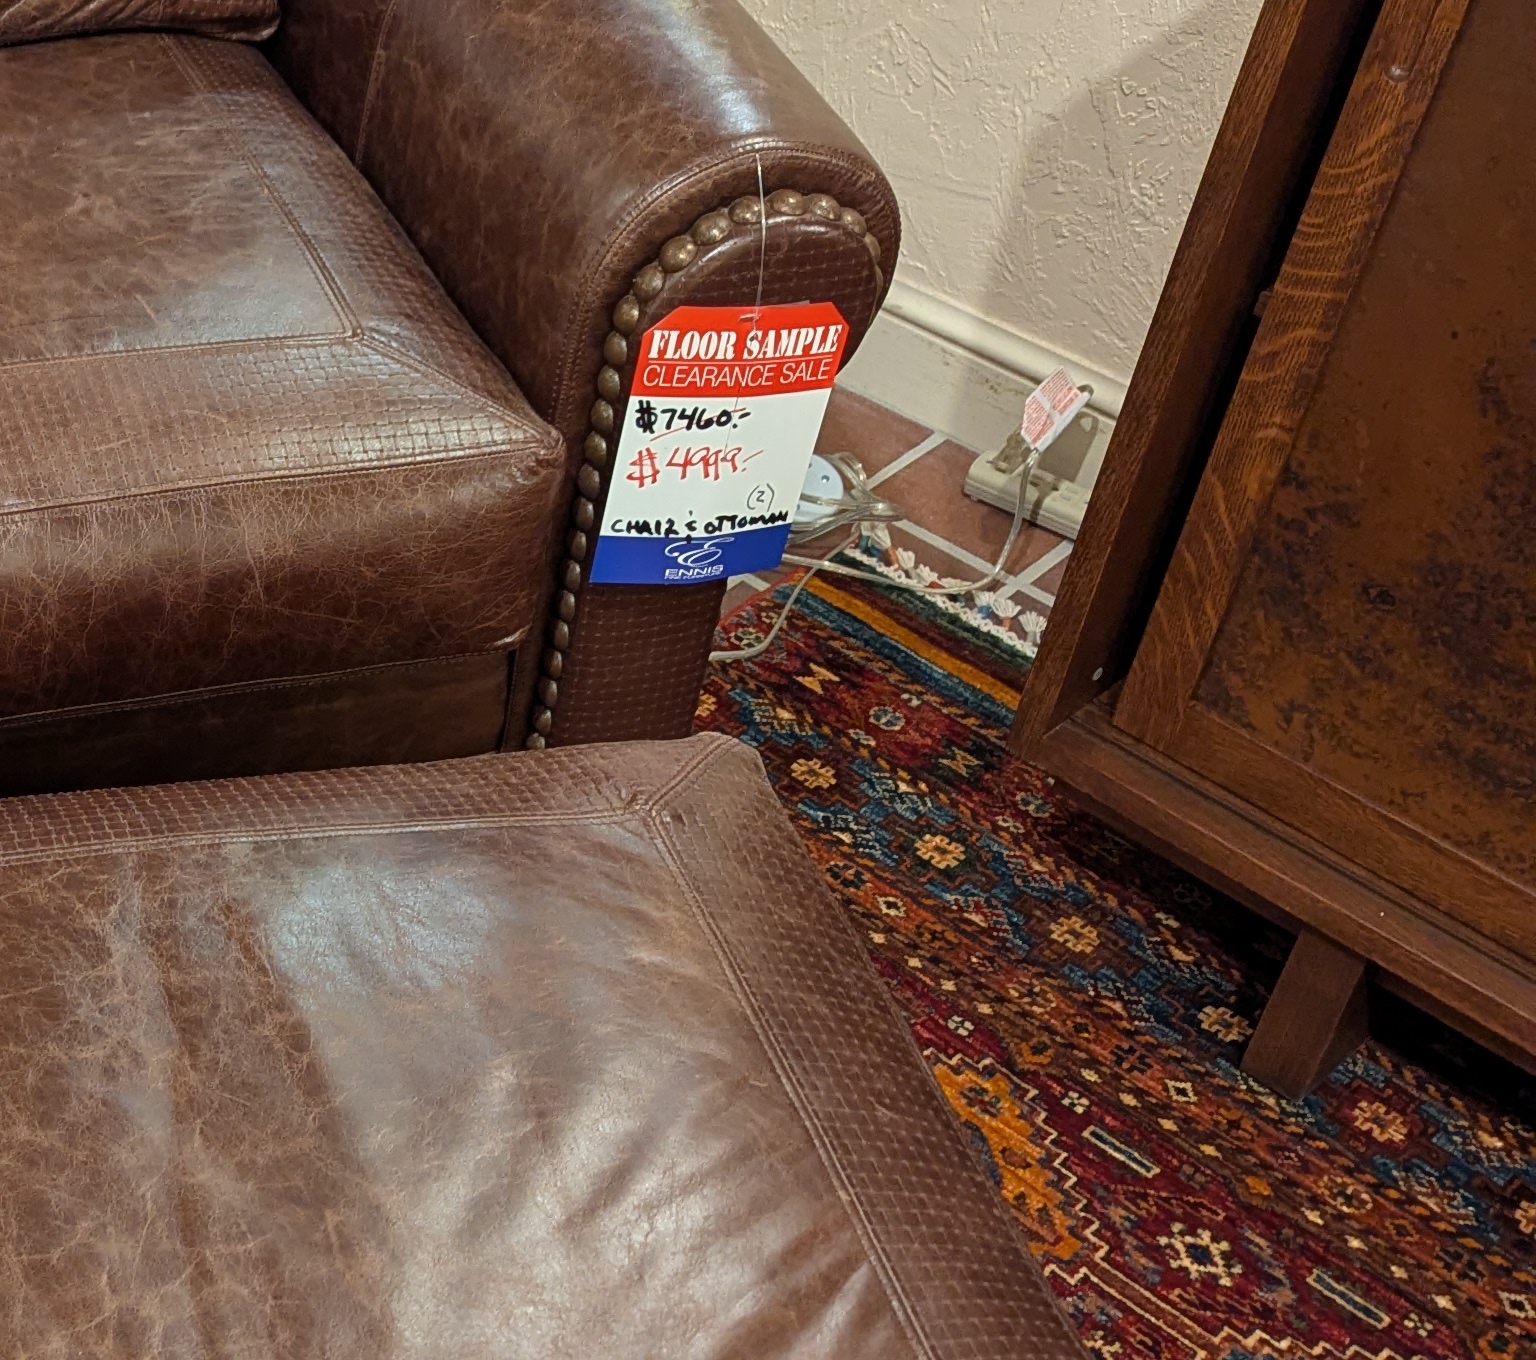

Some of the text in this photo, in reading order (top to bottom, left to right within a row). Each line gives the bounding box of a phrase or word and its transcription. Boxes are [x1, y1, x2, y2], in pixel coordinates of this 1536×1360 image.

[648, 324, 843, 360] FLOOR SAMPLE
[643, 358, 833, 387] CLEARANCE SALE
[665, 564, 724, 578] ENNIS
